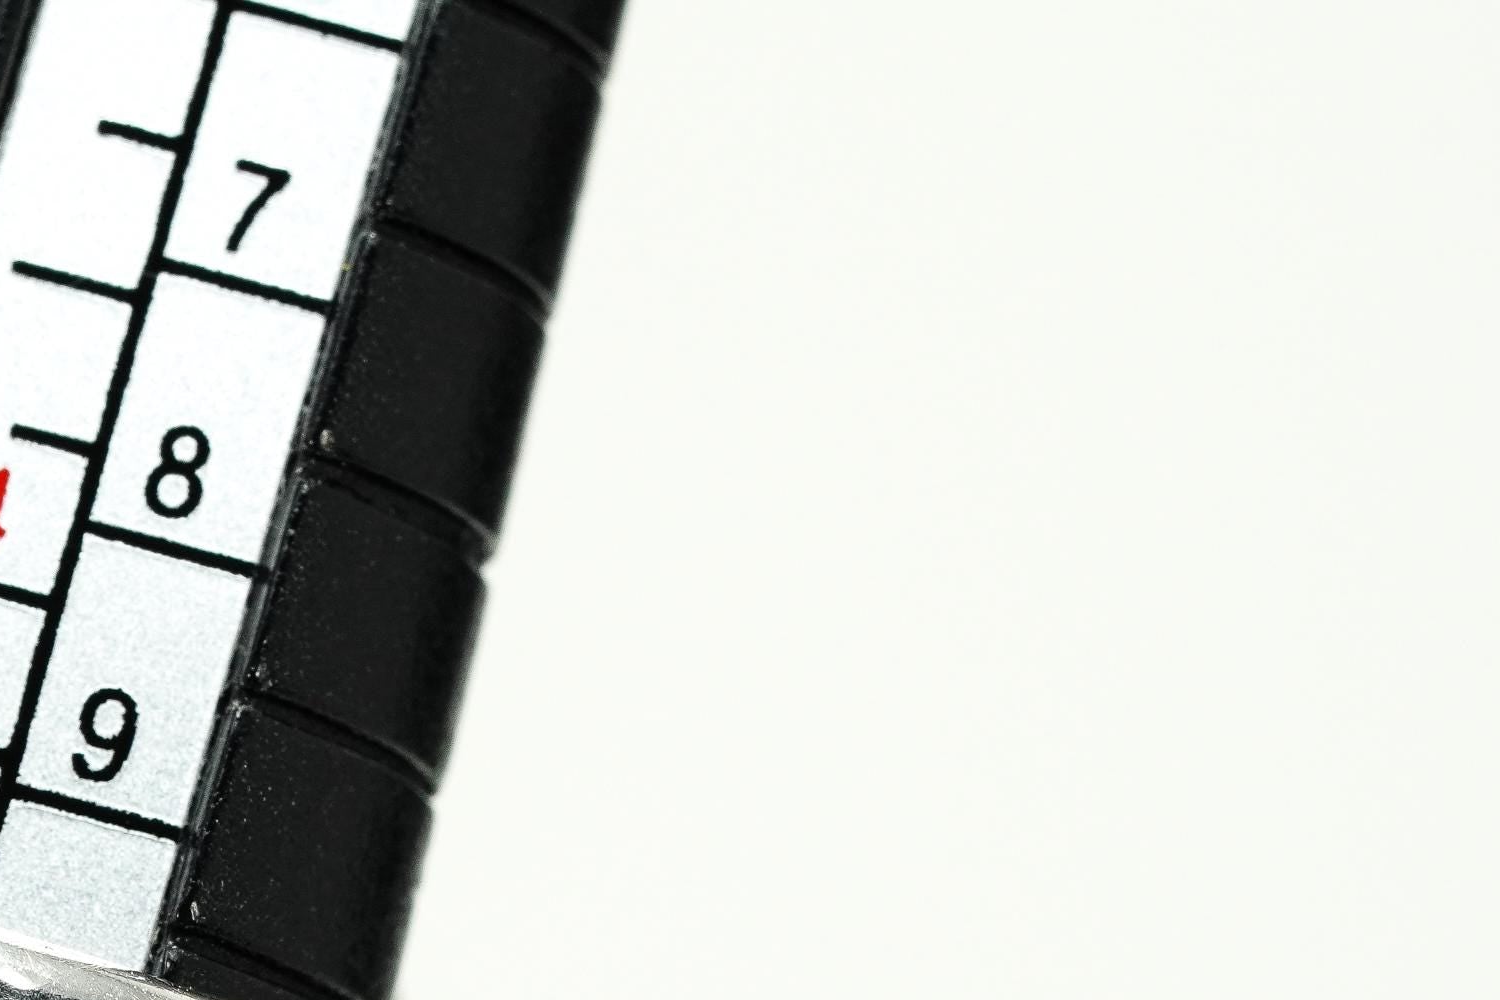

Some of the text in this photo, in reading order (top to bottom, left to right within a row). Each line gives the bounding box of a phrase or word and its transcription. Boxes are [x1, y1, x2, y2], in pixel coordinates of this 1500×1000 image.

[226, 159, 291, 252] 7
[144, 425, 211, 519] 8
[71, 688, 139, 783] 9
